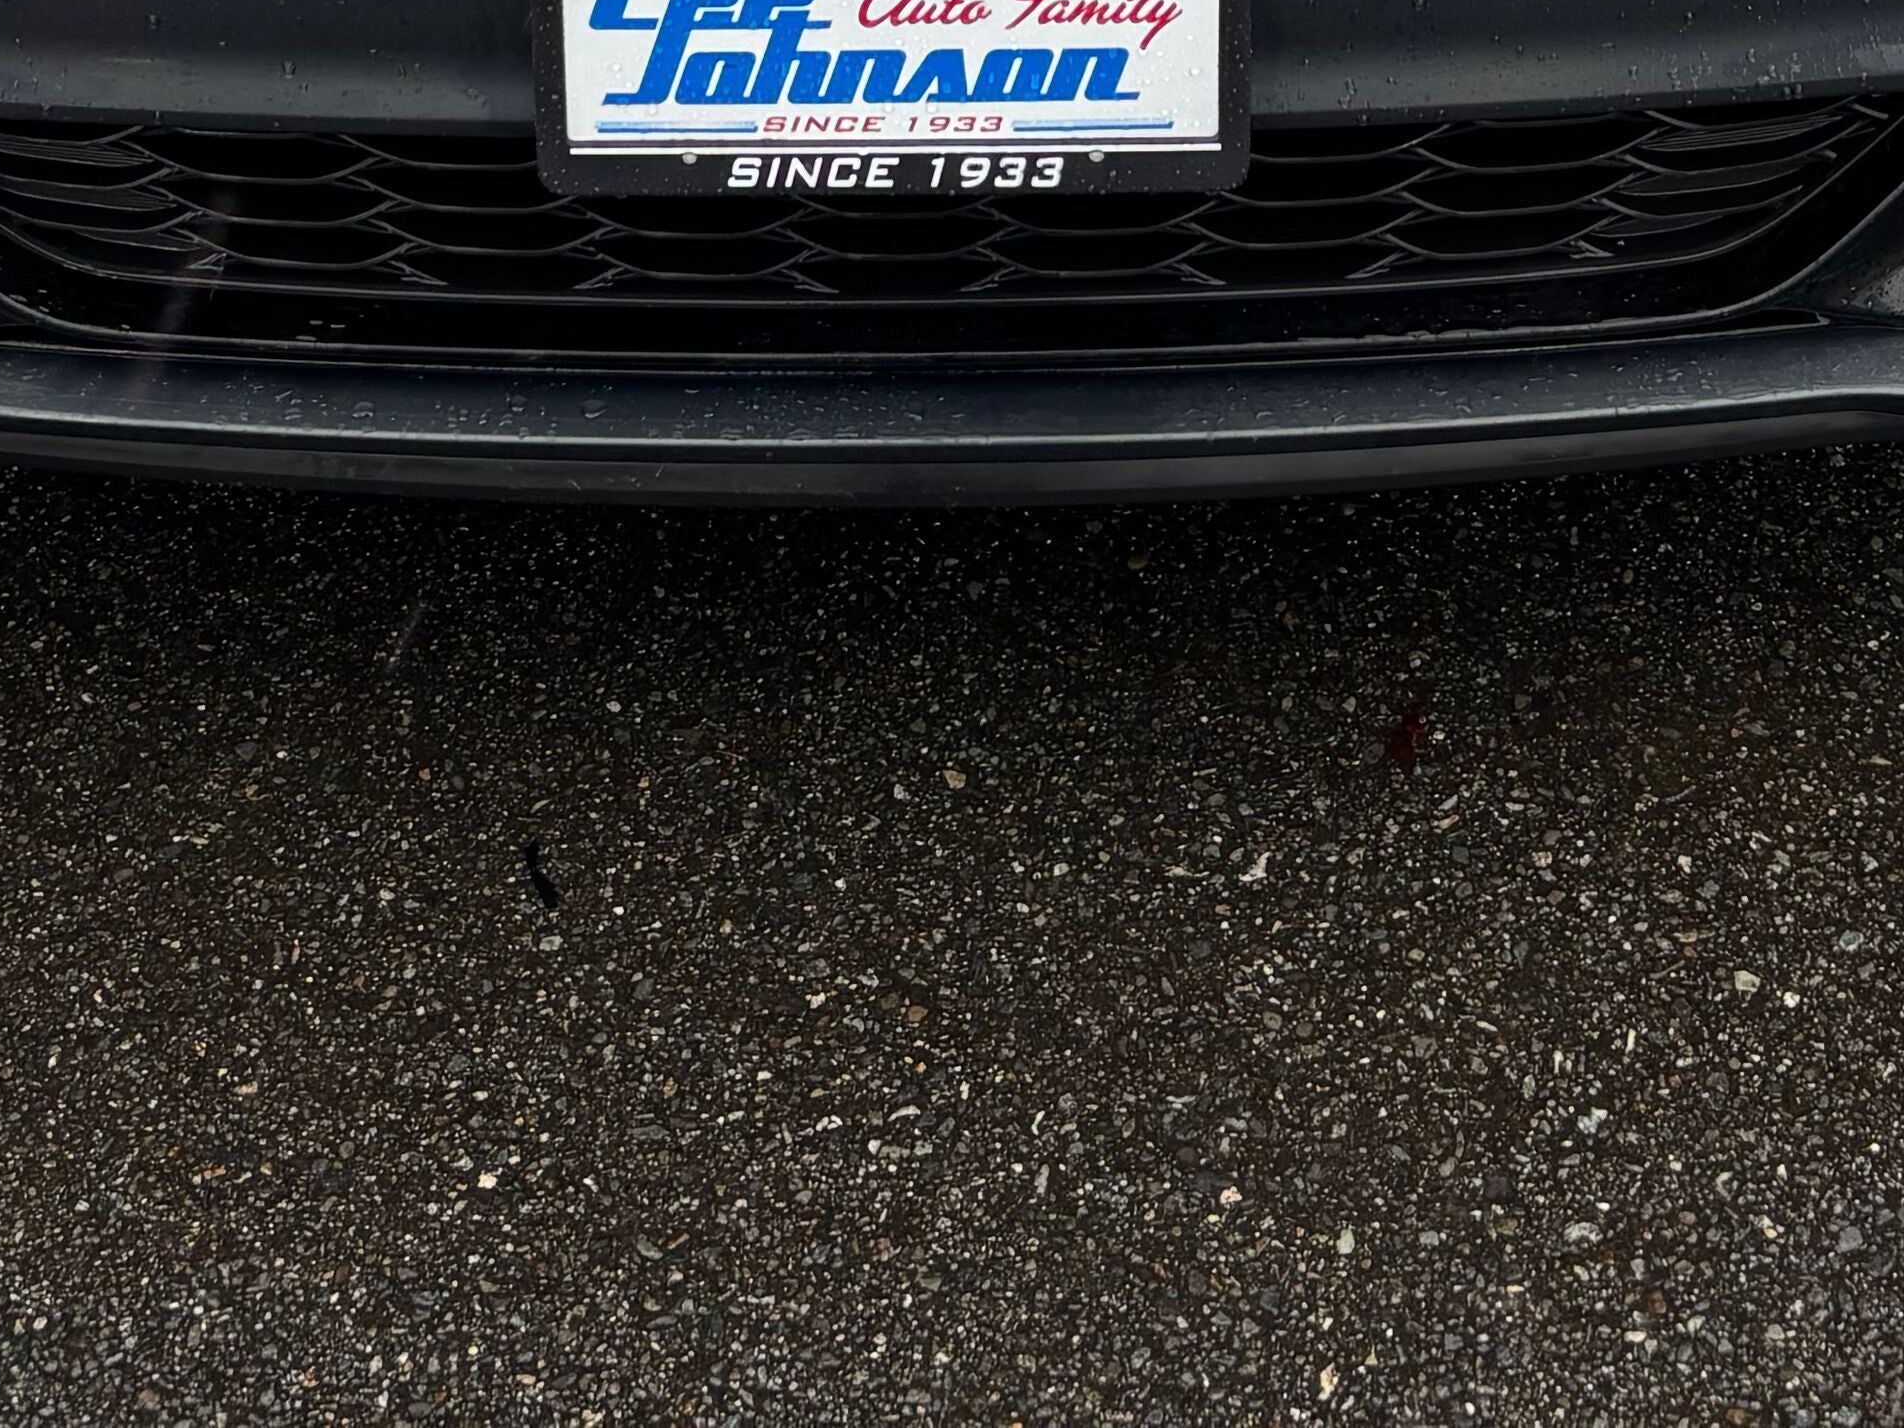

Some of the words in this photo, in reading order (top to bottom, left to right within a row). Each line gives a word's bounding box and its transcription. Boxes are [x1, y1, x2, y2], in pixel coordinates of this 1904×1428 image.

[602, 12, 1140, 105] Johnson
[762, 114, 884, 134] SINCE
[907, 114, 1004, 134] 1933
[727, 156, 900, 189] SINCE
[929, 156, 1065, 189] 1933
